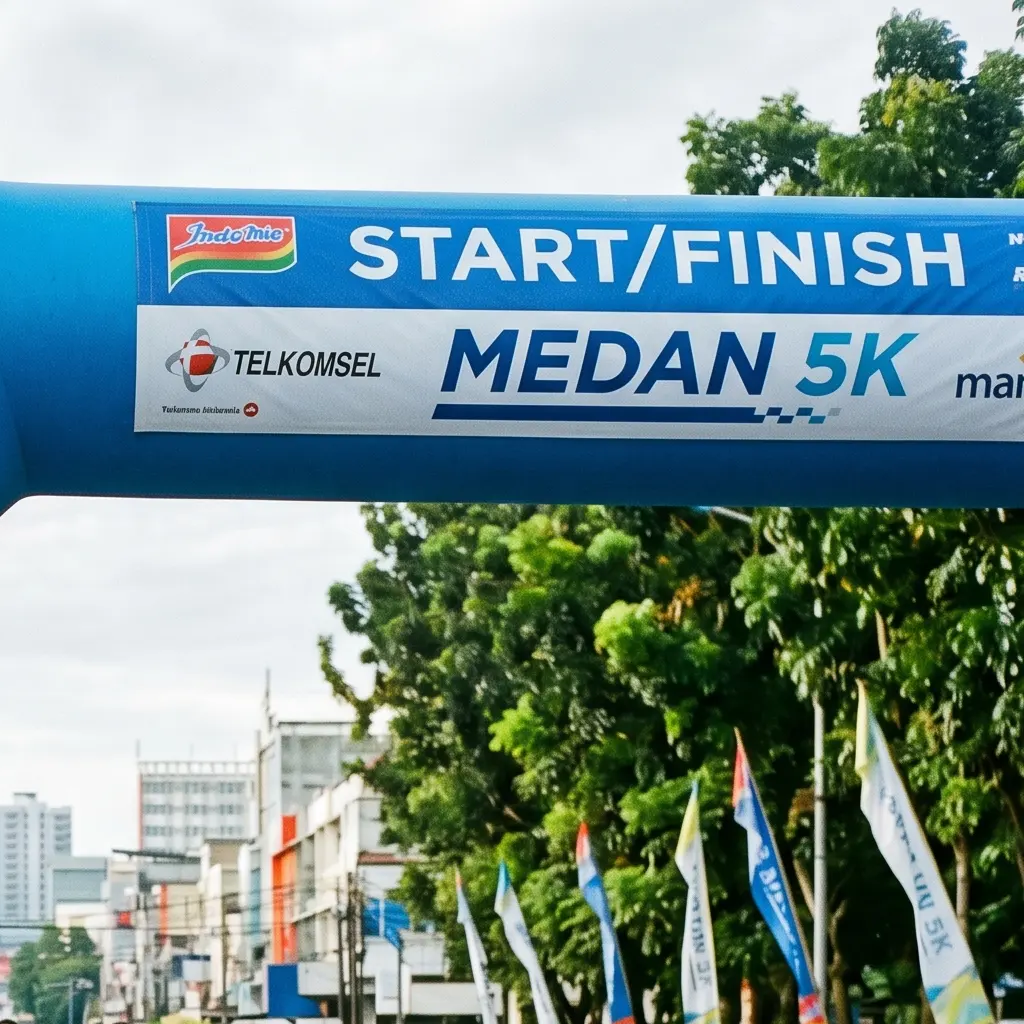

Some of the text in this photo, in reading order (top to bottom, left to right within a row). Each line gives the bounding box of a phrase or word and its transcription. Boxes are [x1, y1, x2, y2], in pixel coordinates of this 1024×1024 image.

[348, 225, 966, 294] START/FINISH
[233, 350, 381, 378] TELKOMSEL
[440, 329, 919, 397] MEDAN 5K
